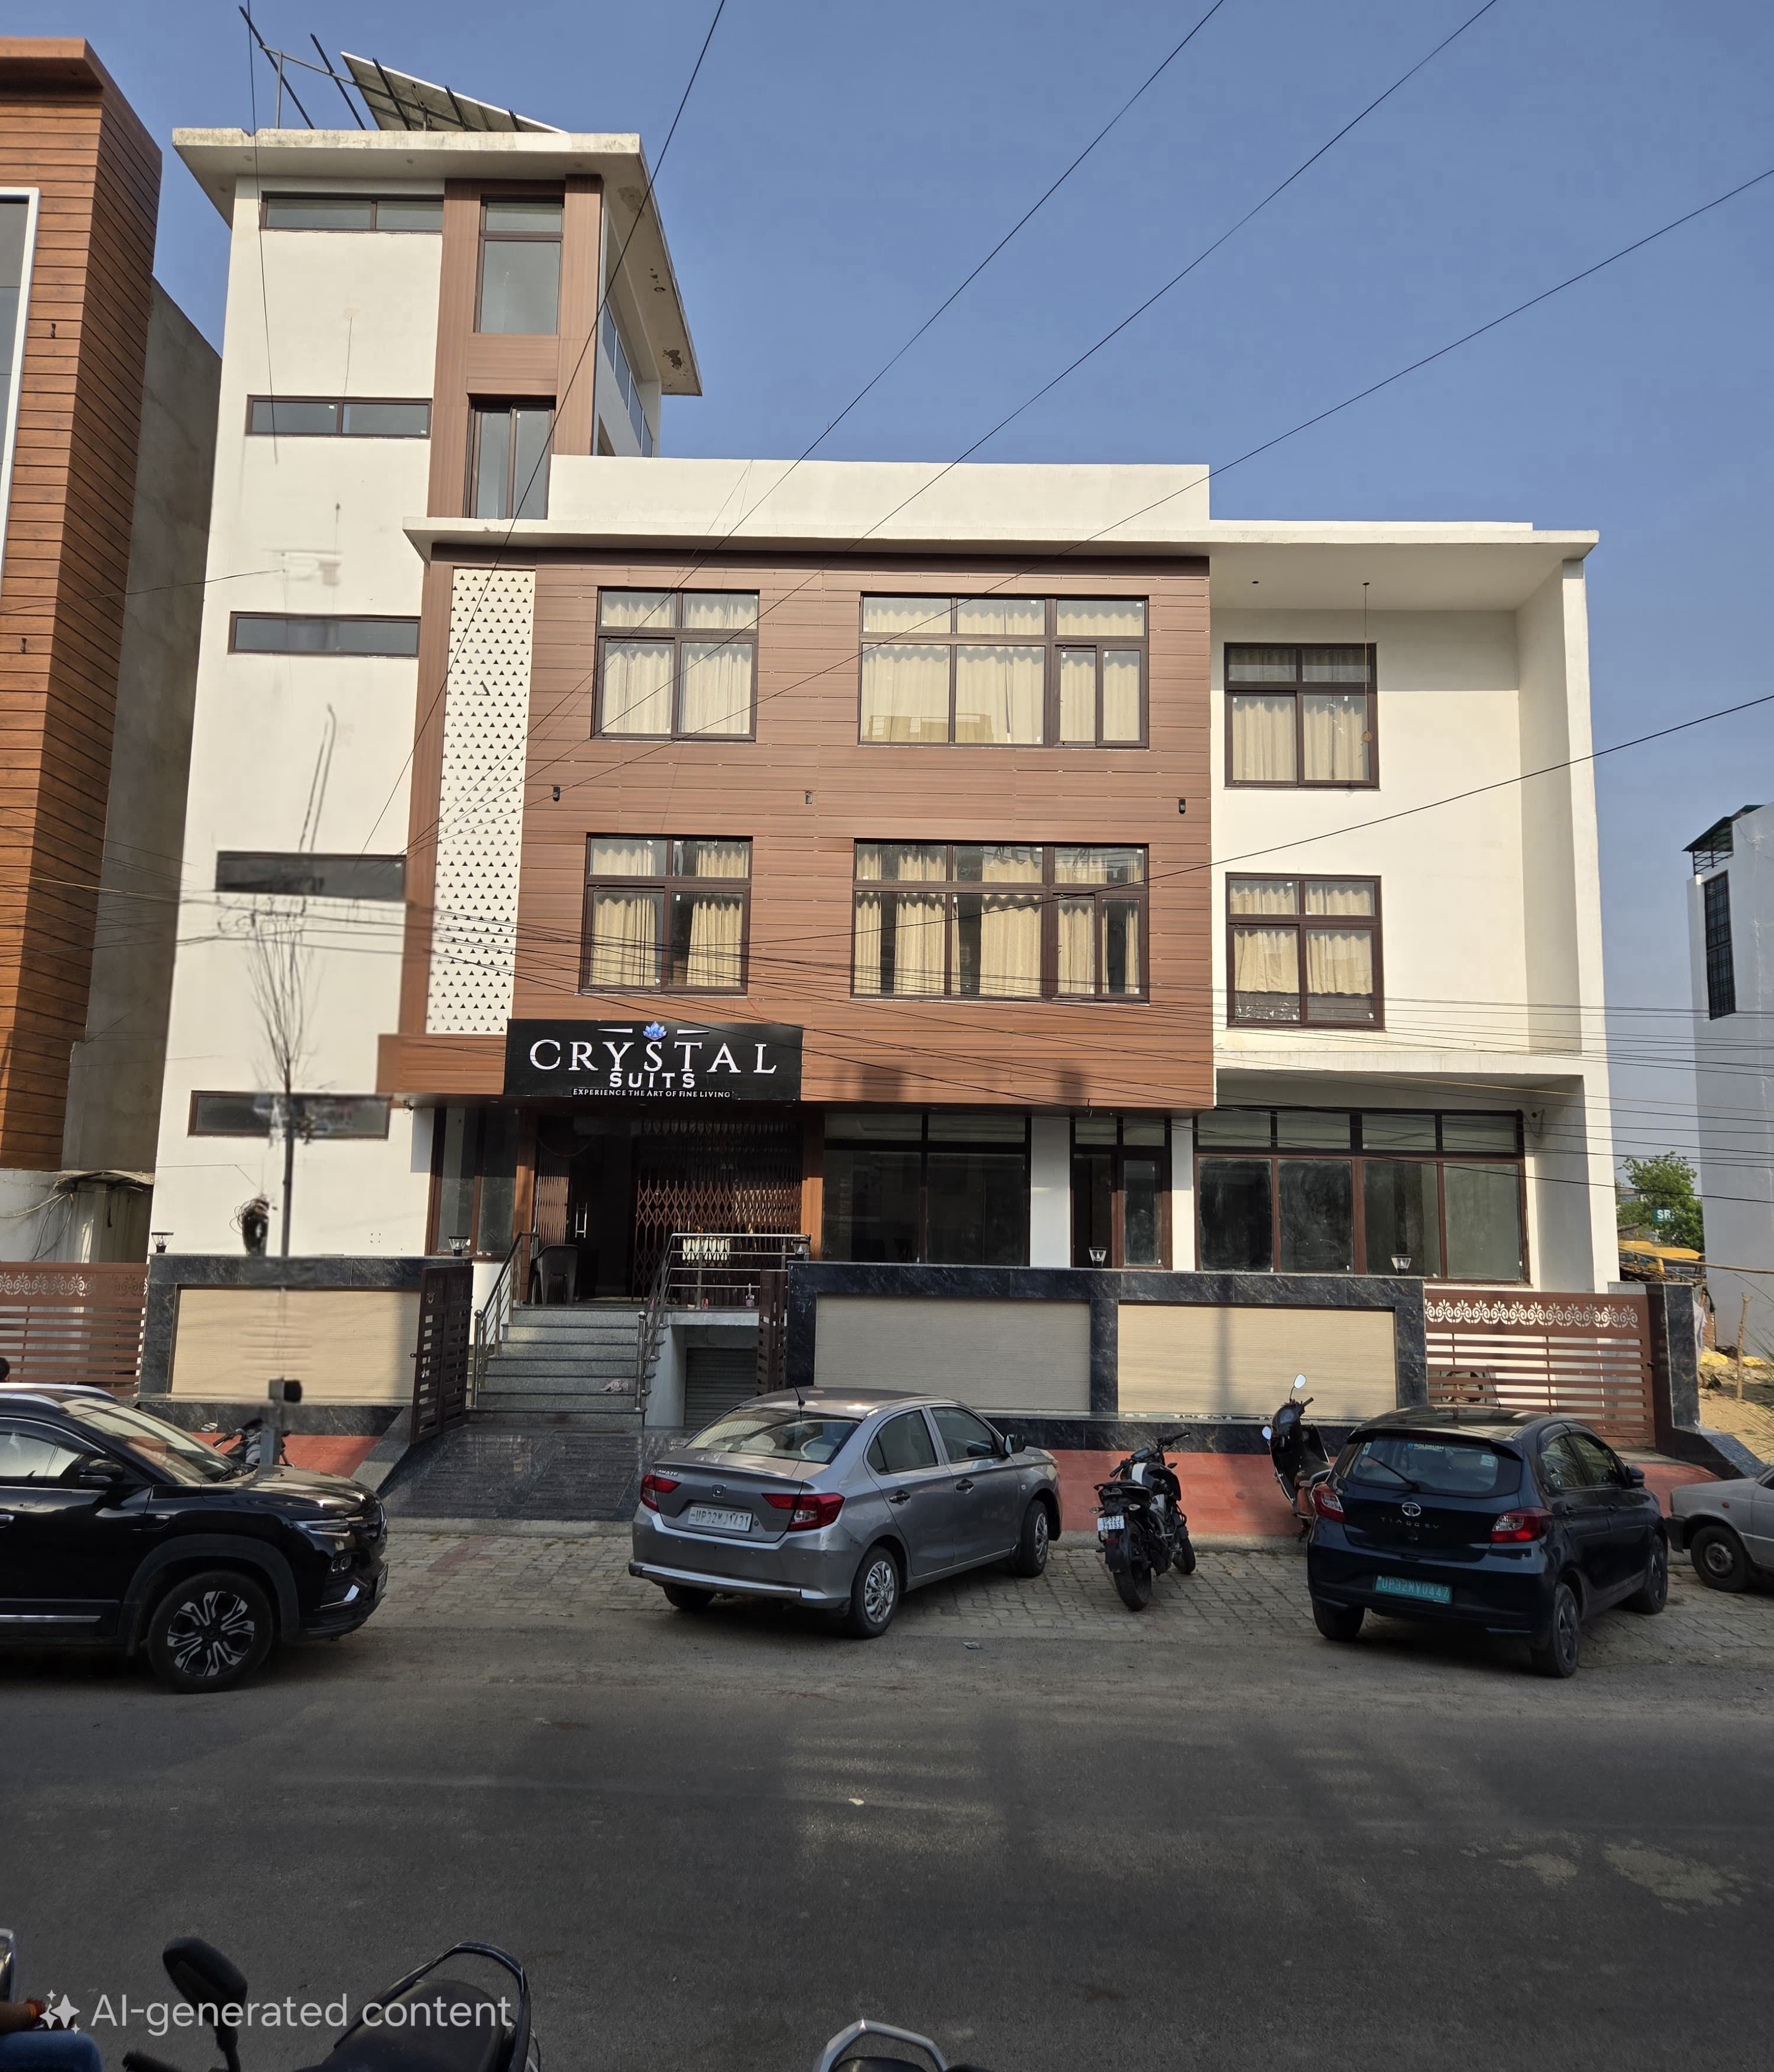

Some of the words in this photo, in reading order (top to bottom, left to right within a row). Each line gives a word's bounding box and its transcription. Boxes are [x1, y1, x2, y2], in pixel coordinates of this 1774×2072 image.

[529, 1039, 777, 1074] CRYSTAL
[609, 1072, 695, 1089] SUITS
[572, 1087, 626, 1096] EXPERIENCE
